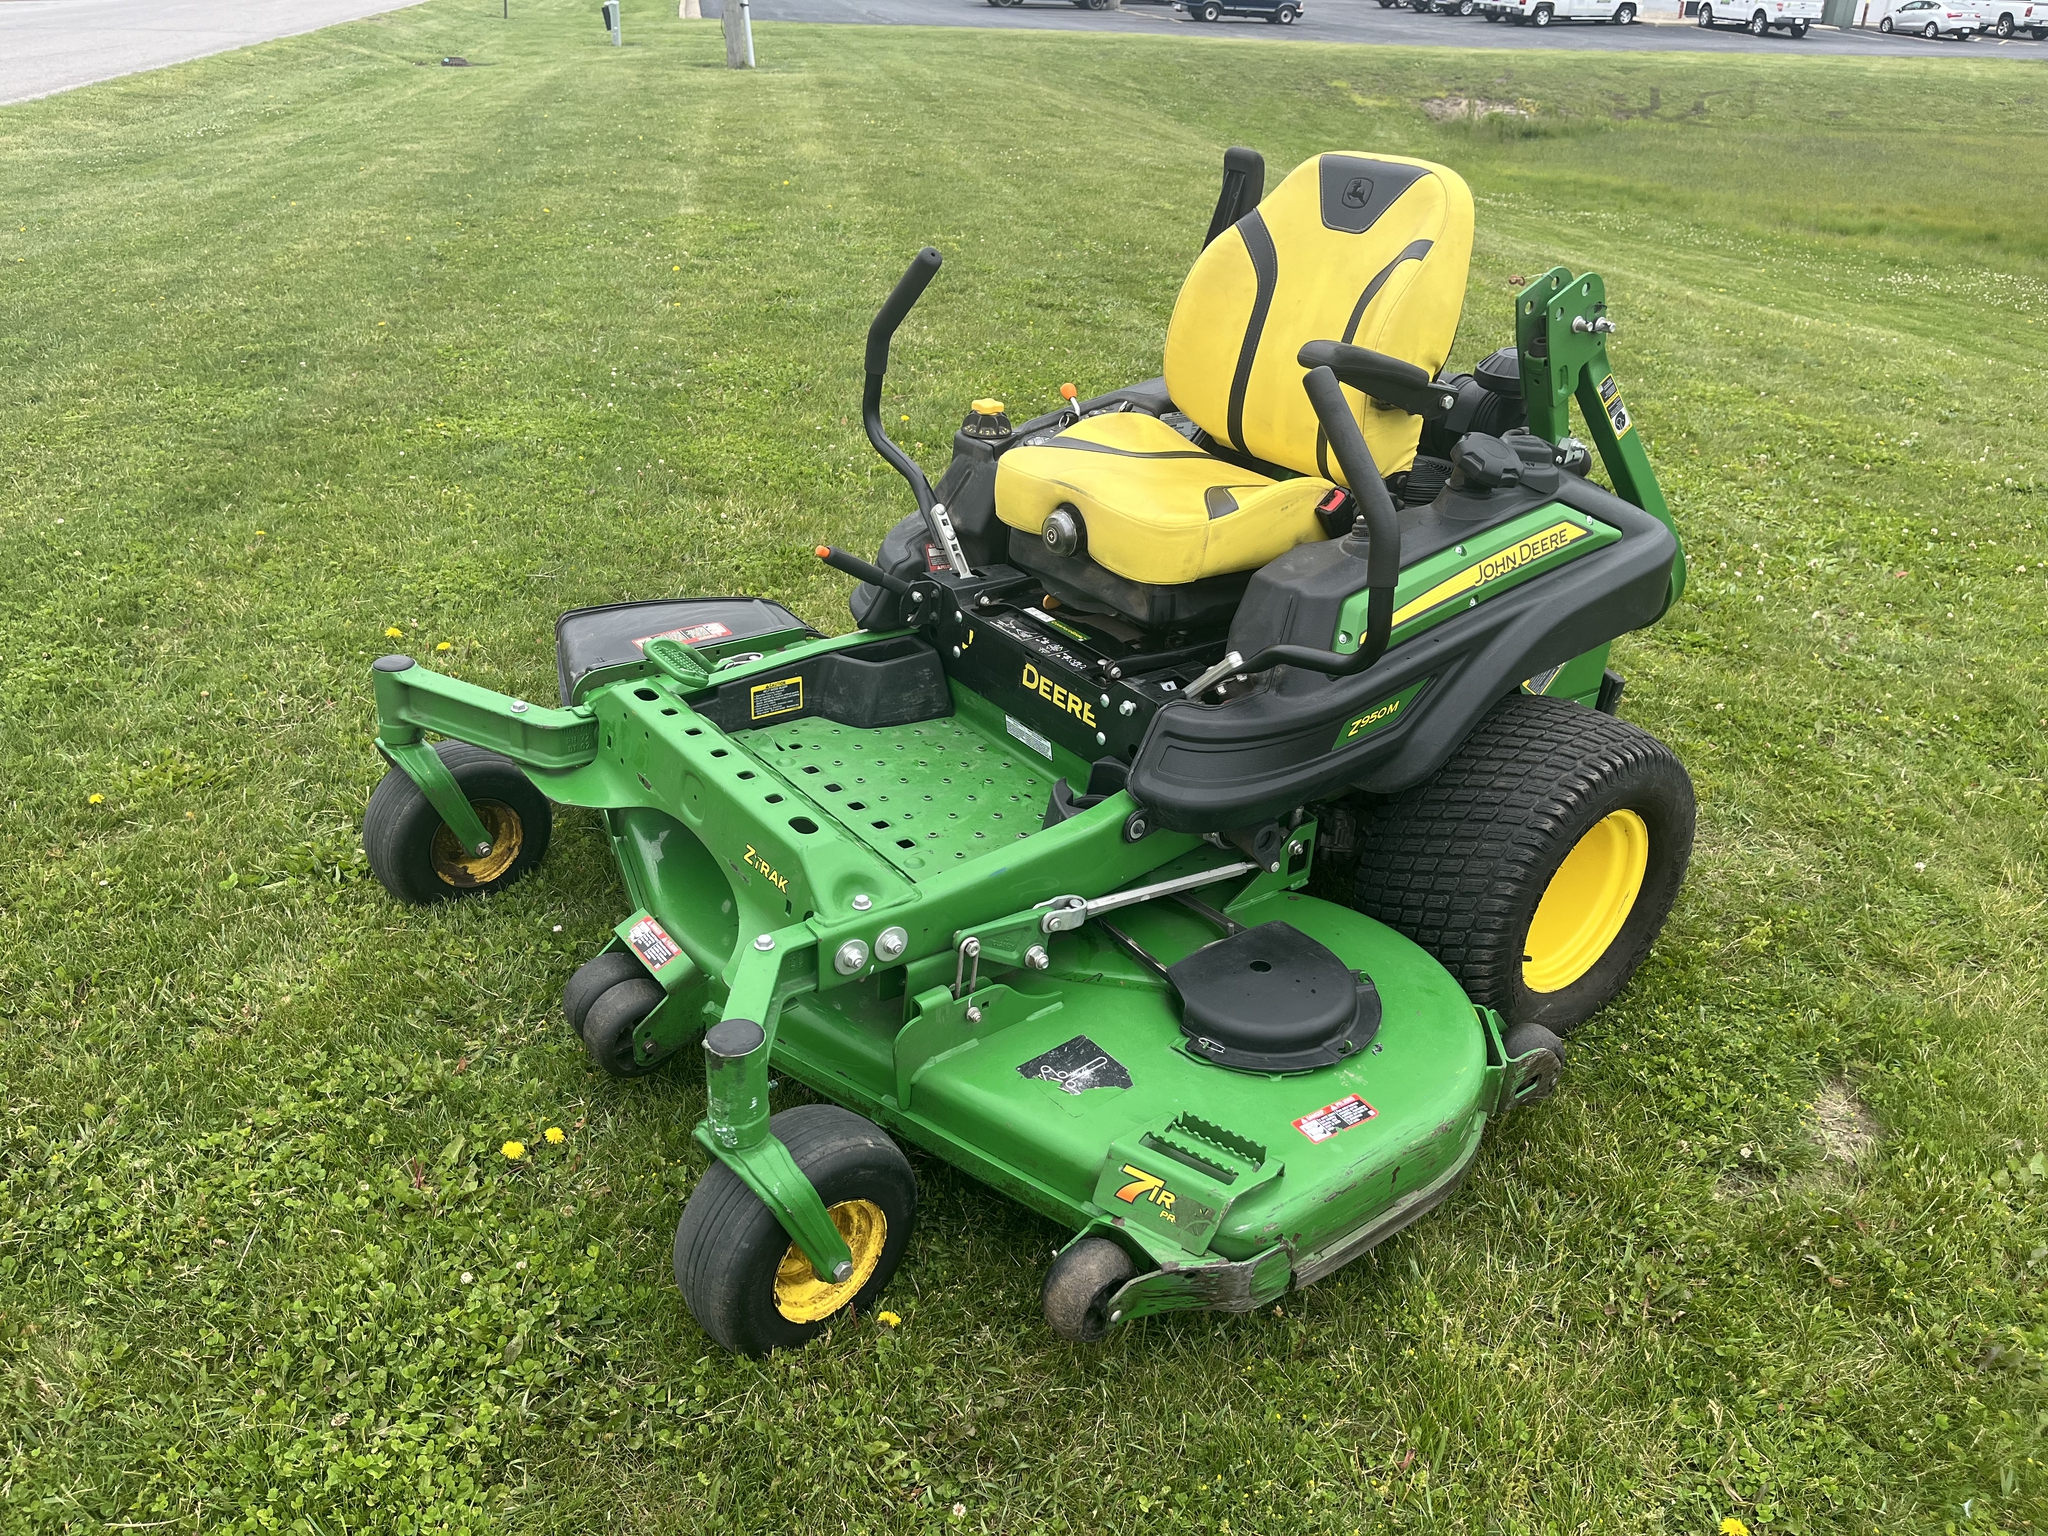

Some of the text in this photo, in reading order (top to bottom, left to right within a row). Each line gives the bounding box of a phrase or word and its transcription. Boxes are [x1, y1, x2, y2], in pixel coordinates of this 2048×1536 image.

[1475, 528, 1568, 584] JOHN DEERE
[1022, 662, 1097, 729] DEERE
[1347, 699, 1400, 738] Z950M
[743, 843, 789, 894] ZTRAK
